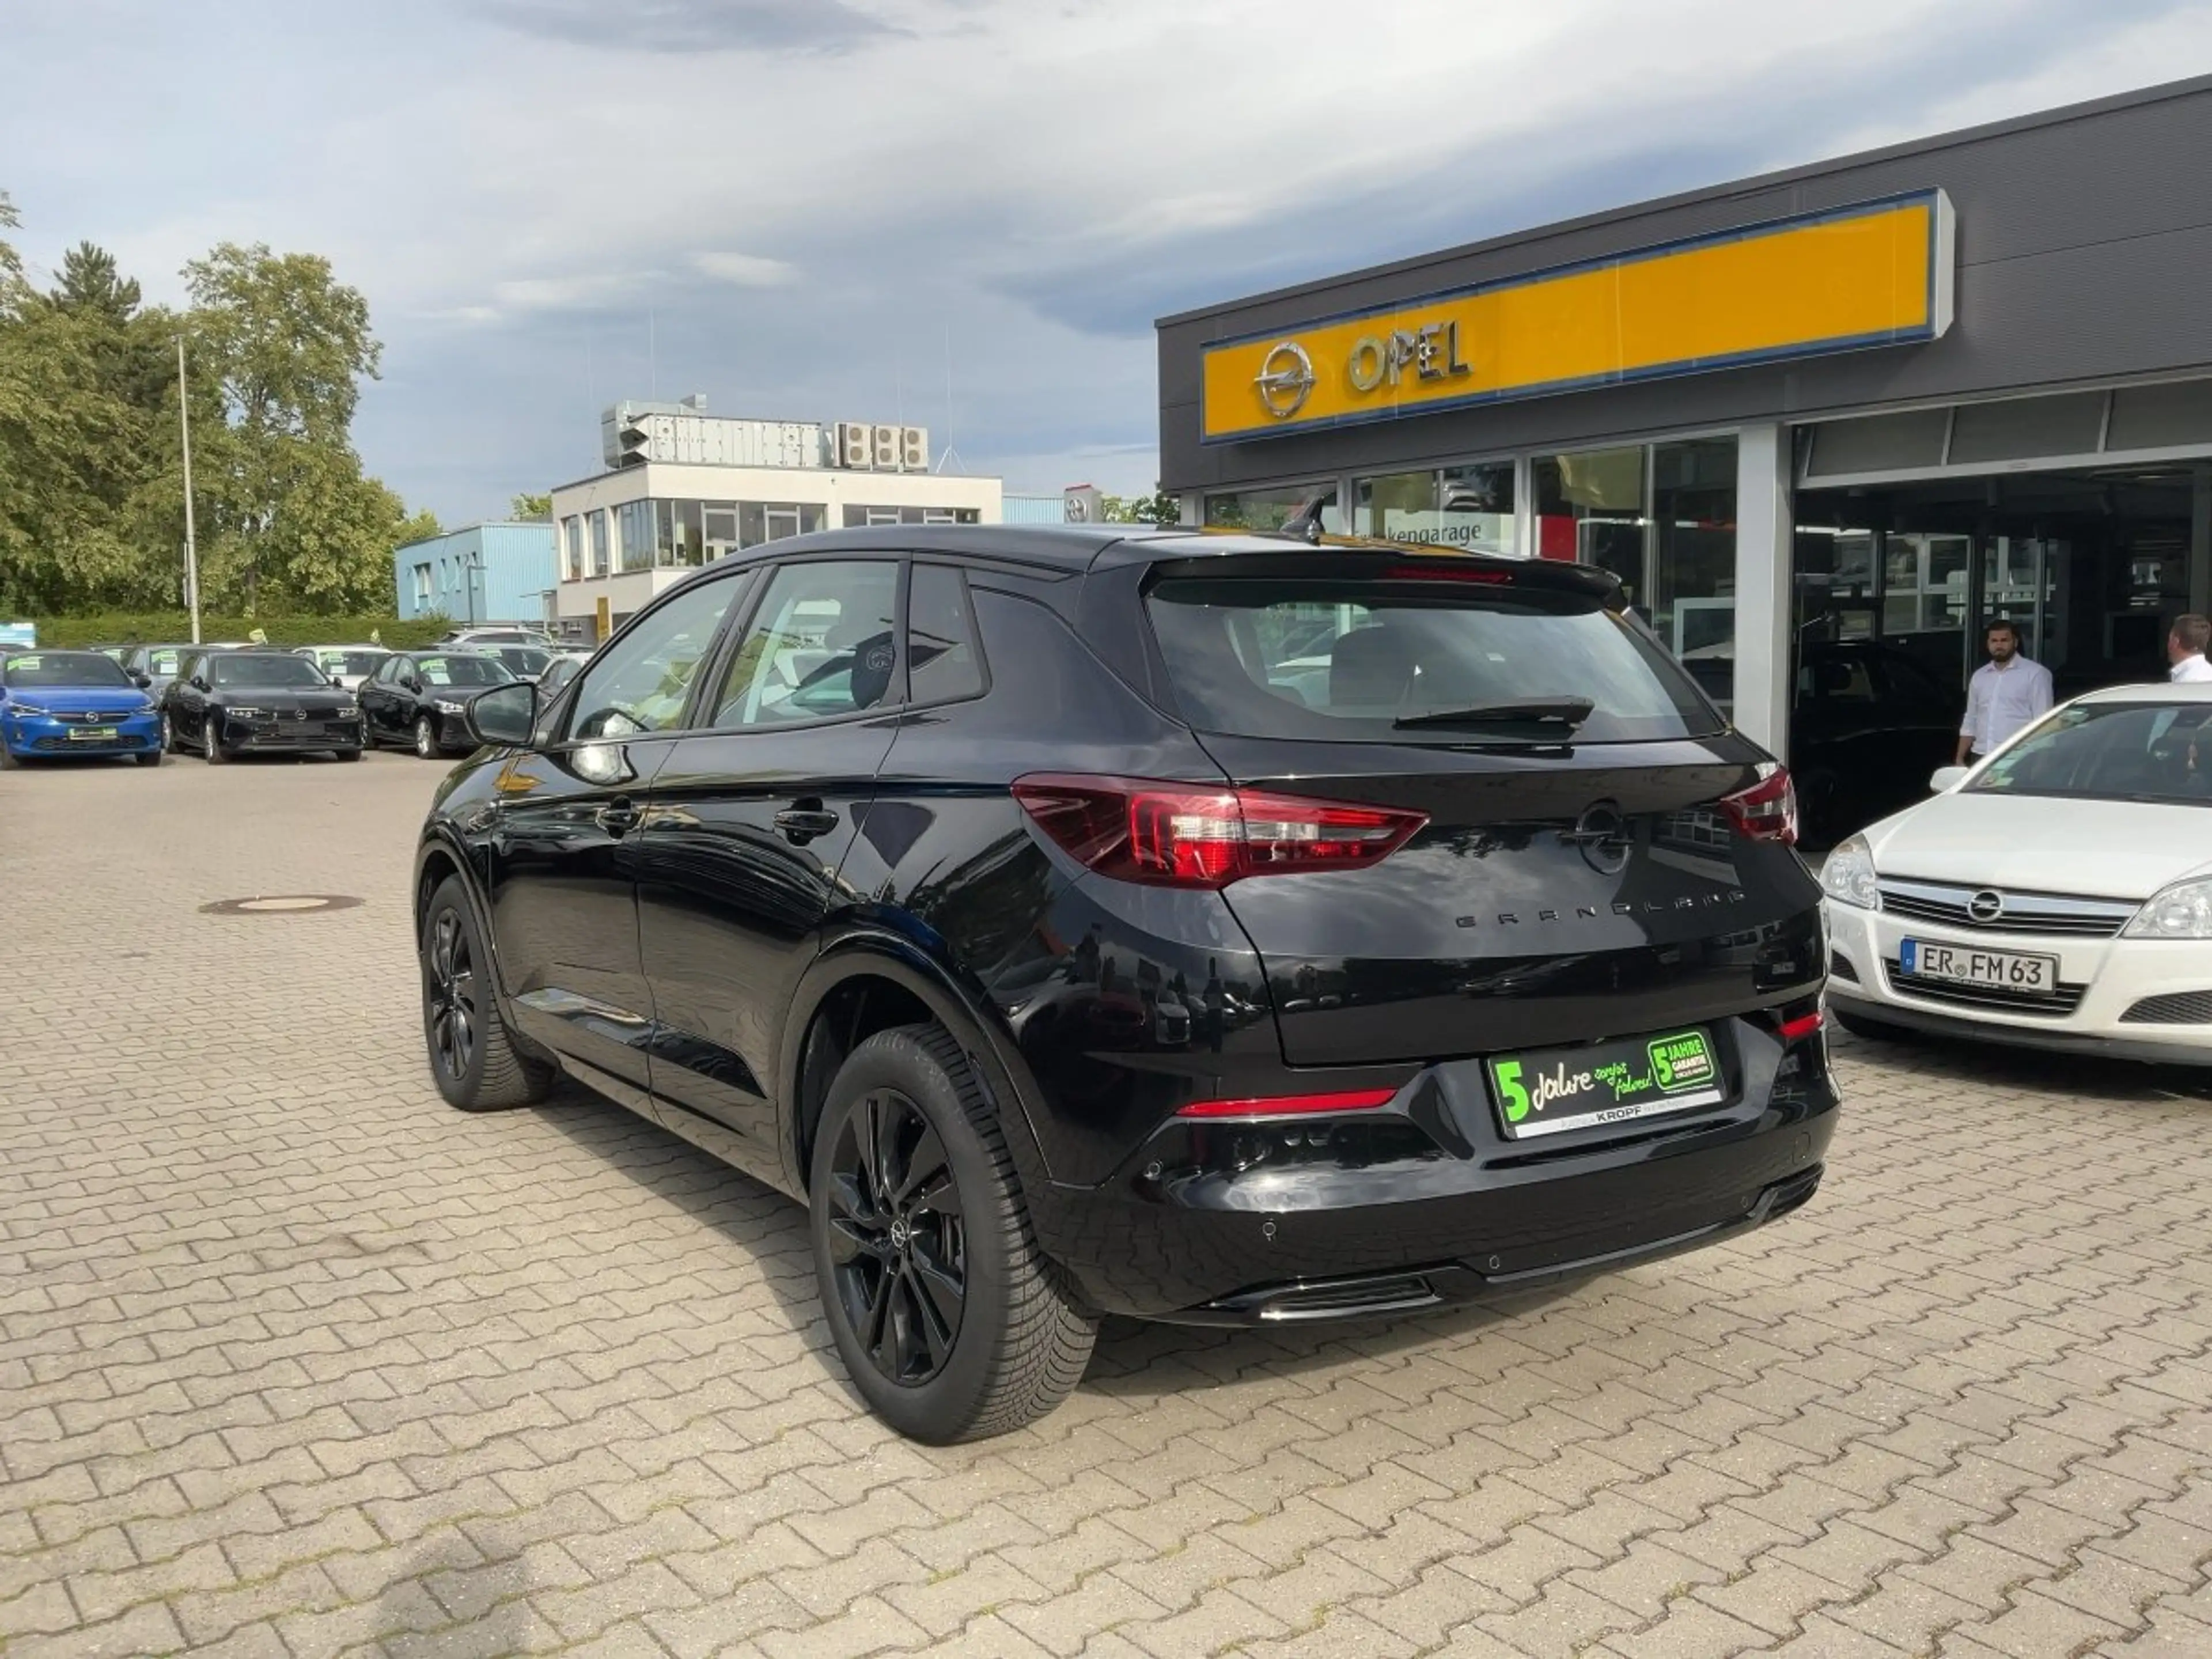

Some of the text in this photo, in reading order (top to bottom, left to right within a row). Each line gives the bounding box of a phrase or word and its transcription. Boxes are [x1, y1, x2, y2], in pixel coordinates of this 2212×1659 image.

[1350, 320, 1472, 391] OPEL
[1924, 947, 1953, 974] ER
[1971, 954, 2003, 981] FM
[2009, 959, 2041, 985] 63
[1653, 1047, 1672, 1084] 5
[1668, 1039, 1703, 1060] JAHRE
[1495, 1061, 1596, 1122] 5 Jahre
[1596, 1105, 1642, 1122] KROPF
